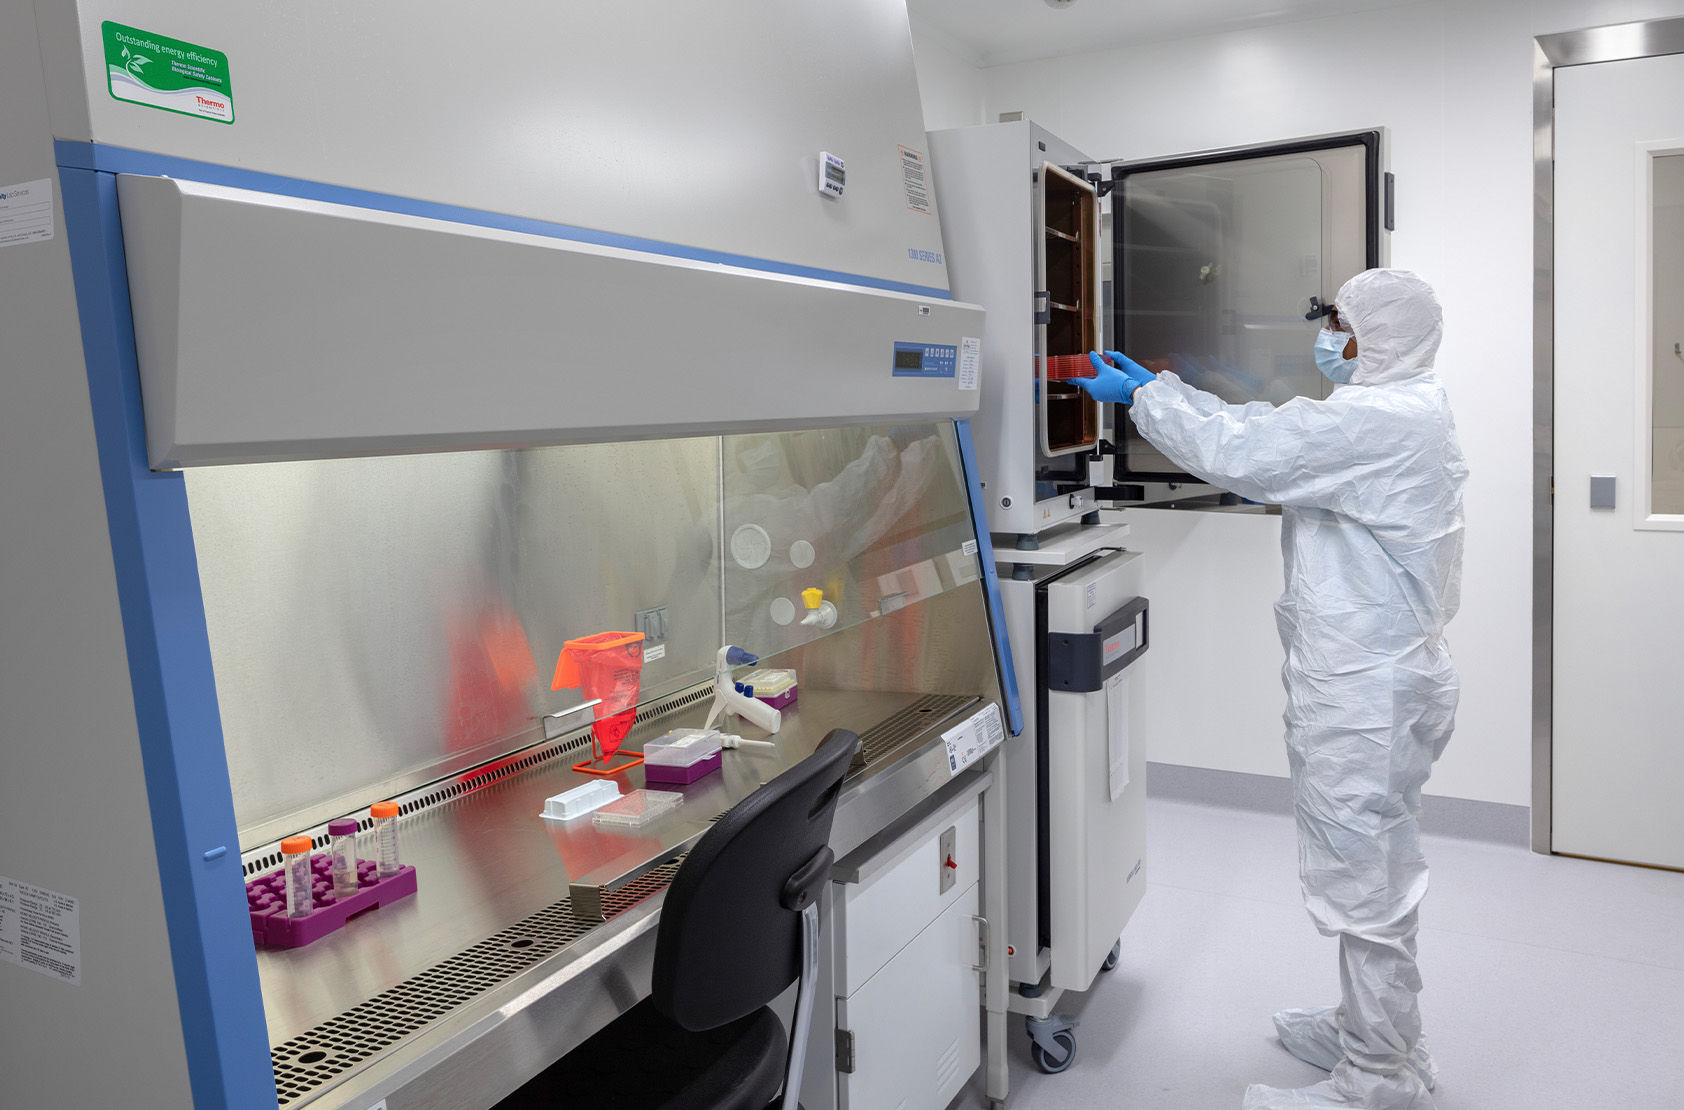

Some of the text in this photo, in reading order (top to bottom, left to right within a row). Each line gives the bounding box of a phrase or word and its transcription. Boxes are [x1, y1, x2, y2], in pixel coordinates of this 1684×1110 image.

[115, 32, 218, 68] Outstanding energy efficiency
[171, 66, 192, 76] Biological
[192, 71, 205, 79] Safety
[205, 75, 222, 83] Cabinets
[187, 64, 206, 73] Scientific
[196, 96, 224, 109] Thermo
[907, 248, 943, 264] 1300 SERIES A2
[1105, 641, 1120, 654] Thermo
